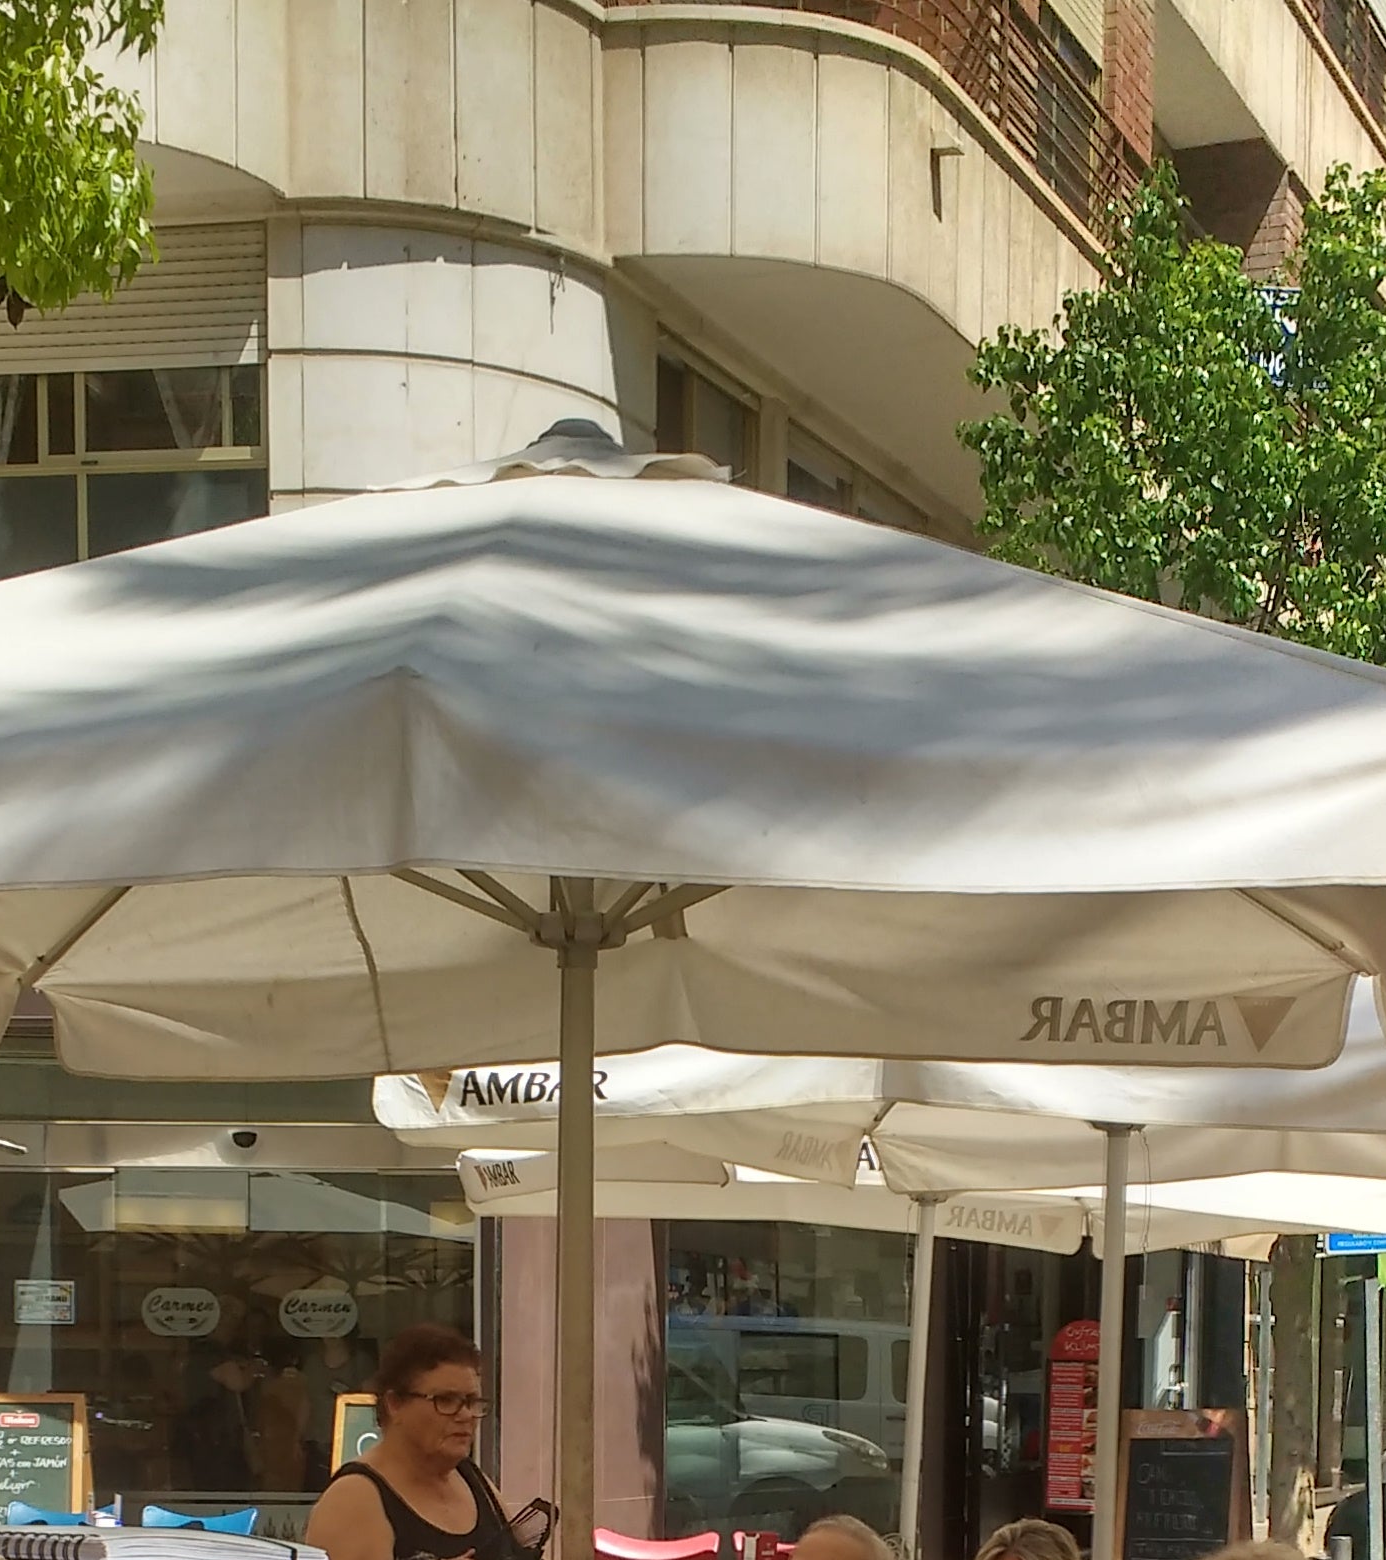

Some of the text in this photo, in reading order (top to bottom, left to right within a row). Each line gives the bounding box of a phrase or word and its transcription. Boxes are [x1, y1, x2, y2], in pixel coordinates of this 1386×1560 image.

[483, 1160, 520, 1189] AMBAR
[148, 1295, 213, 1313] Carmen
[284, 1298, 352, 1315] Carmen
